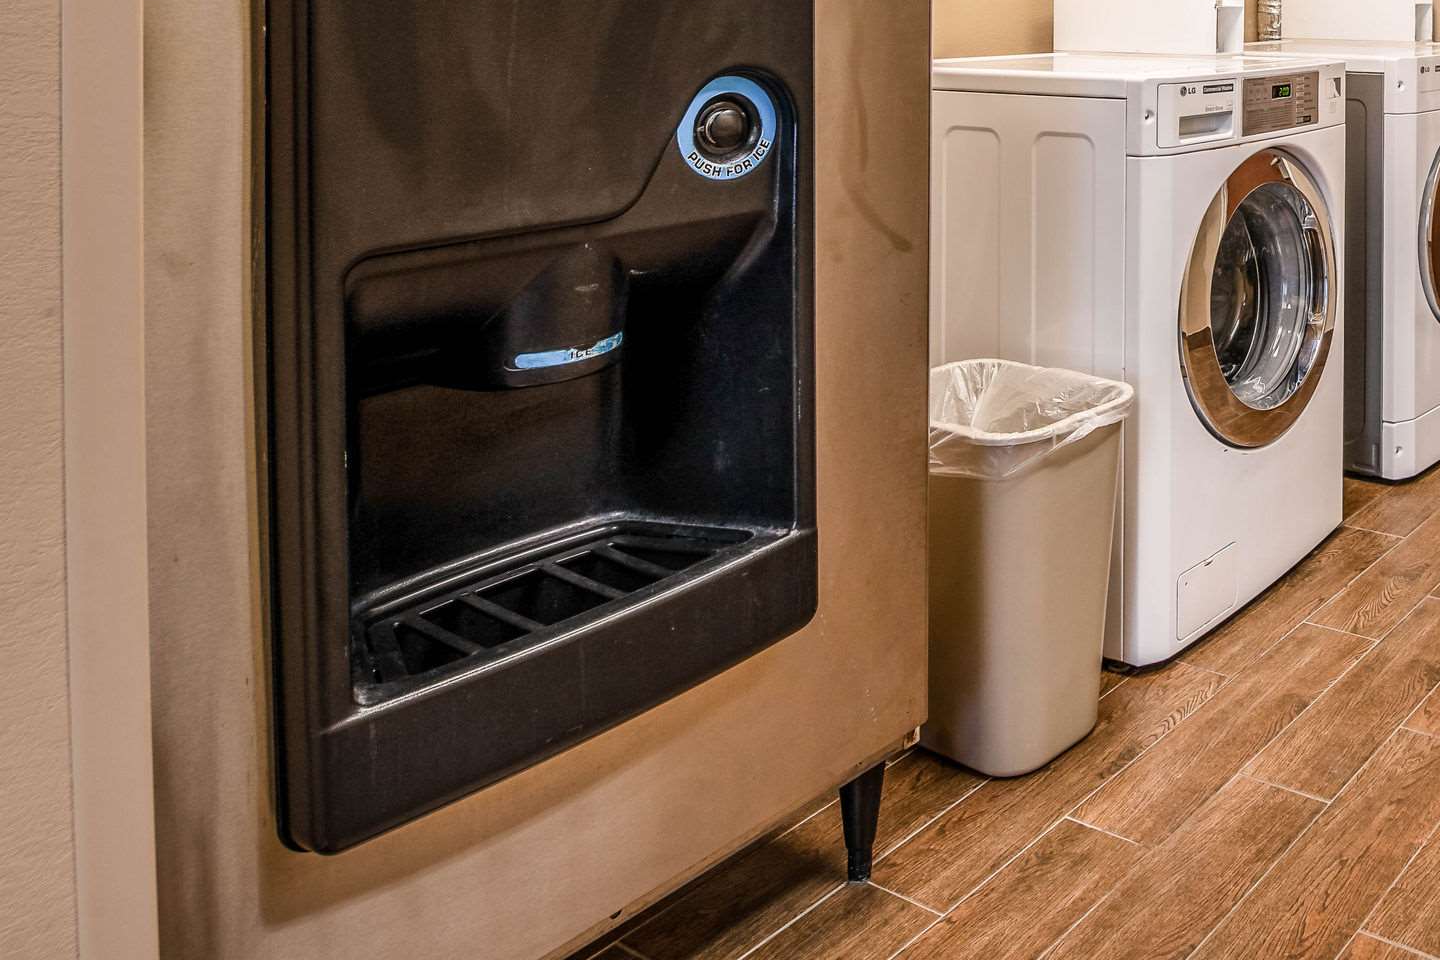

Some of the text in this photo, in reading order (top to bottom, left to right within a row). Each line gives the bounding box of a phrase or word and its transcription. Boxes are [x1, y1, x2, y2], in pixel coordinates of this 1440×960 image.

[1187, 87, 1196, 95] LG
[687, 139, 770, 176] PUSH FOR ICE
[569, 348, 593, 360] ICE
